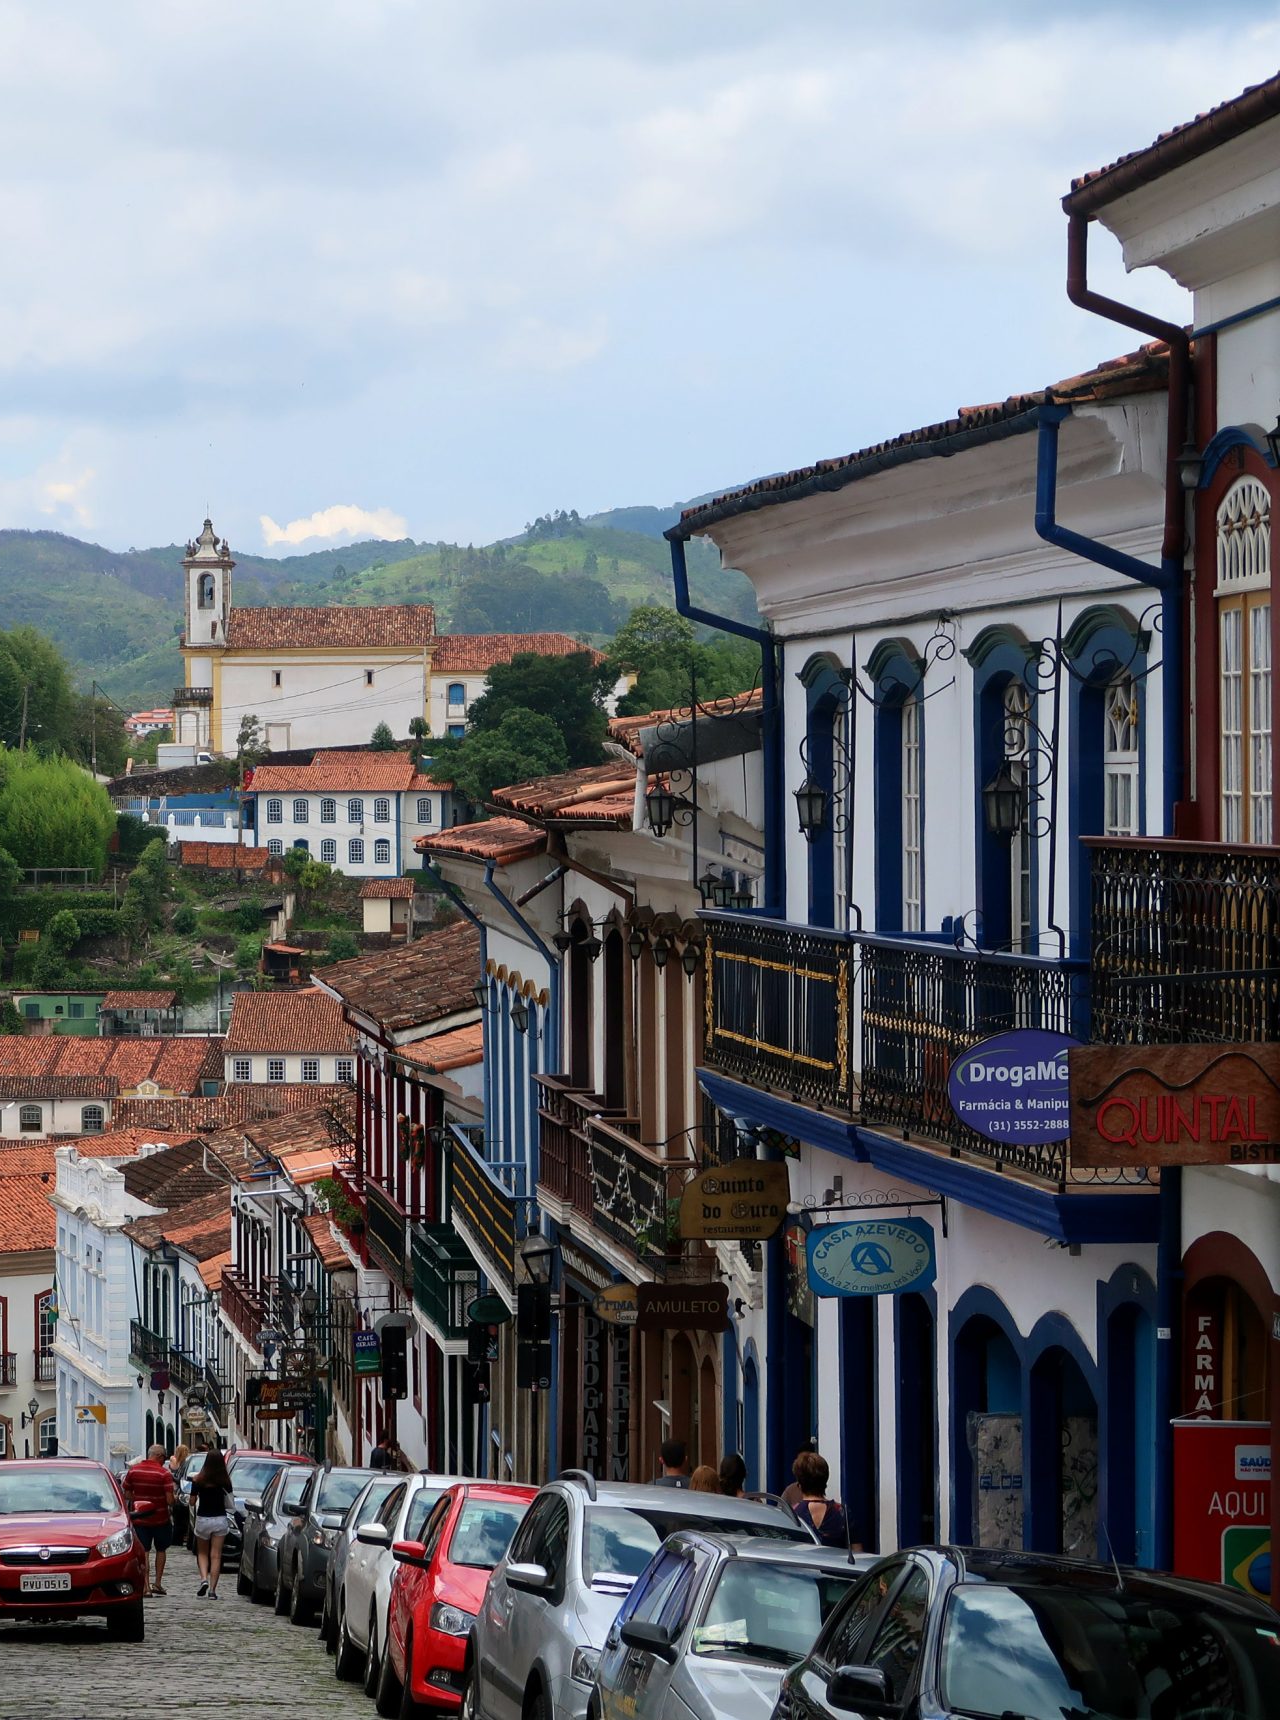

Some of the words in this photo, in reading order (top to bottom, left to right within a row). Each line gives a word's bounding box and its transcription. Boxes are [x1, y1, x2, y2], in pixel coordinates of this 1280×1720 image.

[970, 1061, 1069, 1087] DrogaMe
[959, 1099, 1011, 1111] Farmácia
[1015, 1099, 1024, 1110] &
[988, 1120, 1011, 1132] (31)
[1014, 1119, 1070, 1131] 3552-2888
[1096, 1095, 1269, 1148] QUINTAL
[701, 1176, 765, 1195] Quinto
[702, 1203, 721, 1219] do
[703, 1225, 762, 1234] restaurante
[815, 1229, 852, 1260] CASA
[856, 1223, 926, 1254] AZEVEDO
[860, 1283, 891, 1292] melhor
[645, 1301, 720, 1313] AMULETO
[1208, 1490, 1265, 1519] AQUI
[22, 1580, 41, 1590] PVU
[44, 1579, 69, 1589] 0515
